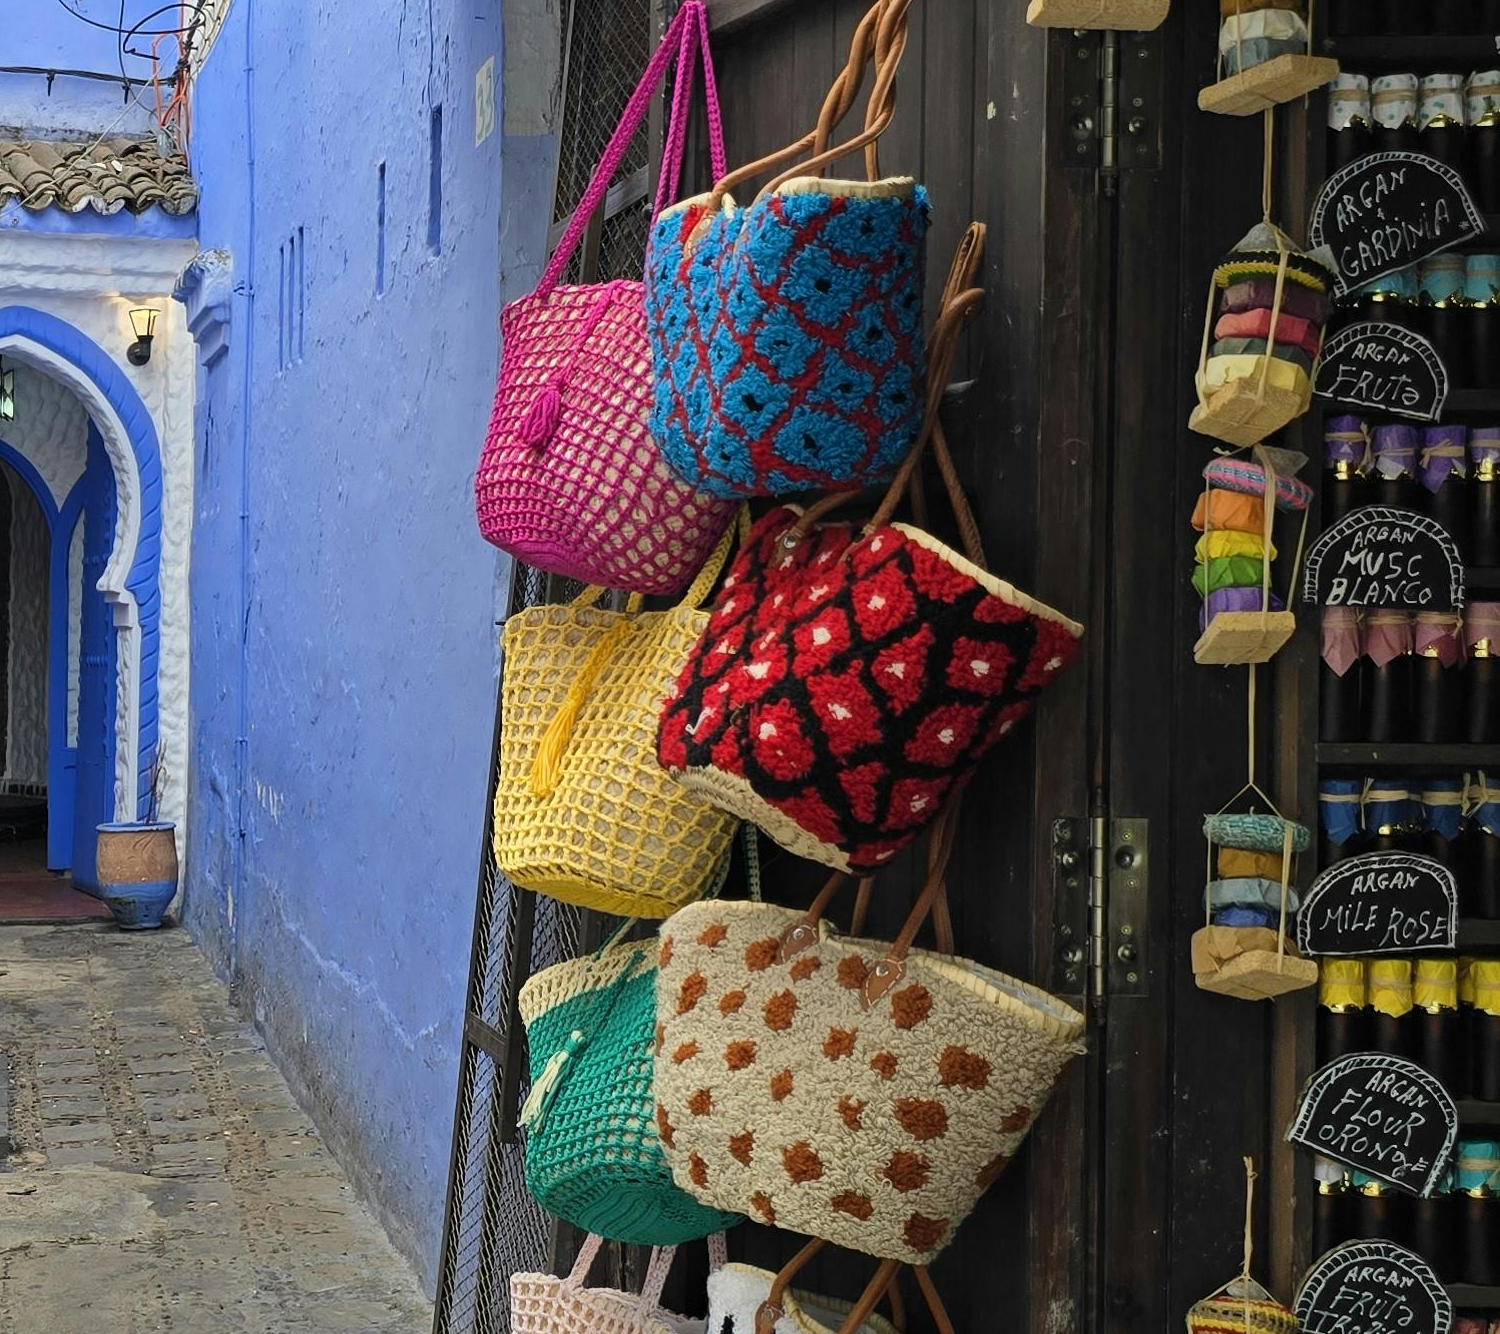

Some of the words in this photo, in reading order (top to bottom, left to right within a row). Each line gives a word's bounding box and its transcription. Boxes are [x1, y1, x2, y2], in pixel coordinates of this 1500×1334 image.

[1336, 168, 1406, 232] ARGAN
[1351, 343, 1412, 365] ARGAN
[1351, 526, 1421, 552] ARGAN
[1338, 548, 1423, 579] MUSC
[1350, 871, 1420, 895] ARGAN
[1379, 907, 1447, 947] ROSE
[1364, 1070, 1430, 1108] ARGAN
[1331, 1088, 1426, 1147] FLOUR
[1344, 1266, 1414, 1289] ARGAN
